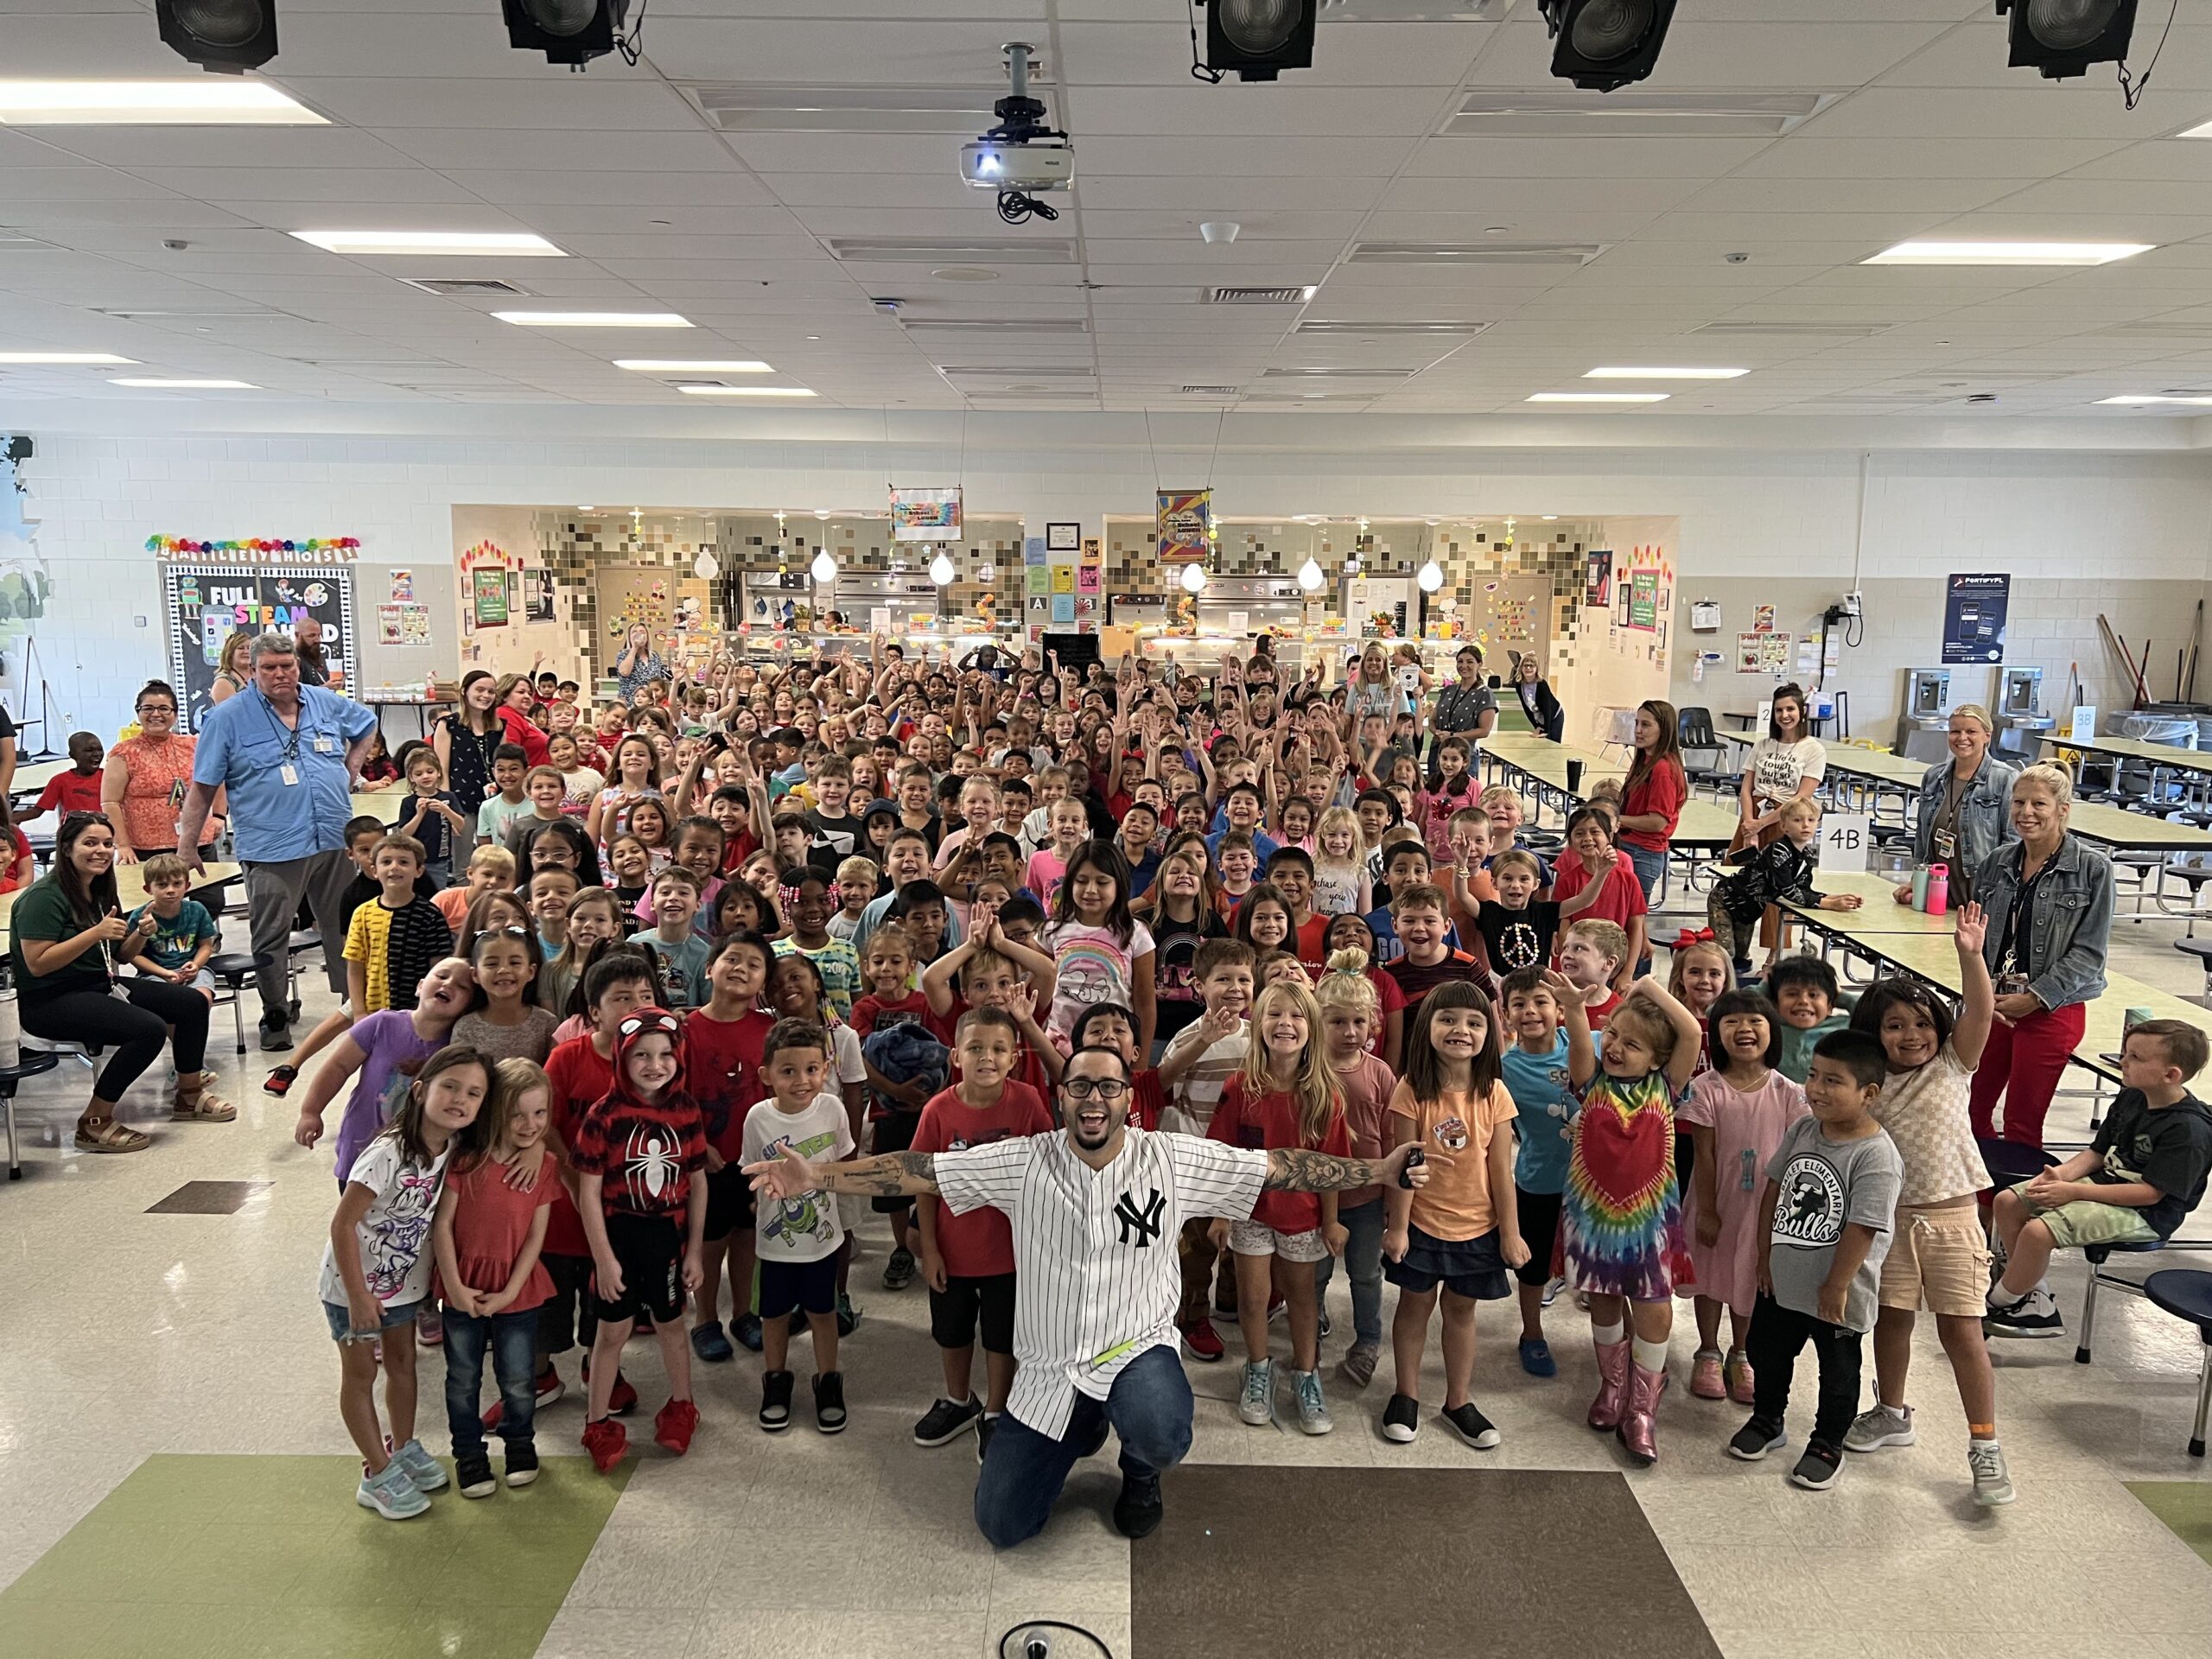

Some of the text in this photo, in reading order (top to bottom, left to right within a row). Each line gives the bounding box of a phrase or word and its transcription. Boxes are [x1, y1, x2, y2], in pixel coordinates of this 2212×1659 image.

[210, 586, 258, 606] FULL
[1033, 598, 1044, 609] A
[234, 605, 309, 625] STEAM
[2077, 714, 2092, 726] 3B
[1829, 828, 1859, 849] 4B
[1781, 1160, 1842, 1217] BAILEY ELEMENTARY
[1113, 1187, 1168, 1249] NY
[1772, 1205, 1836, 1243] Bulls
